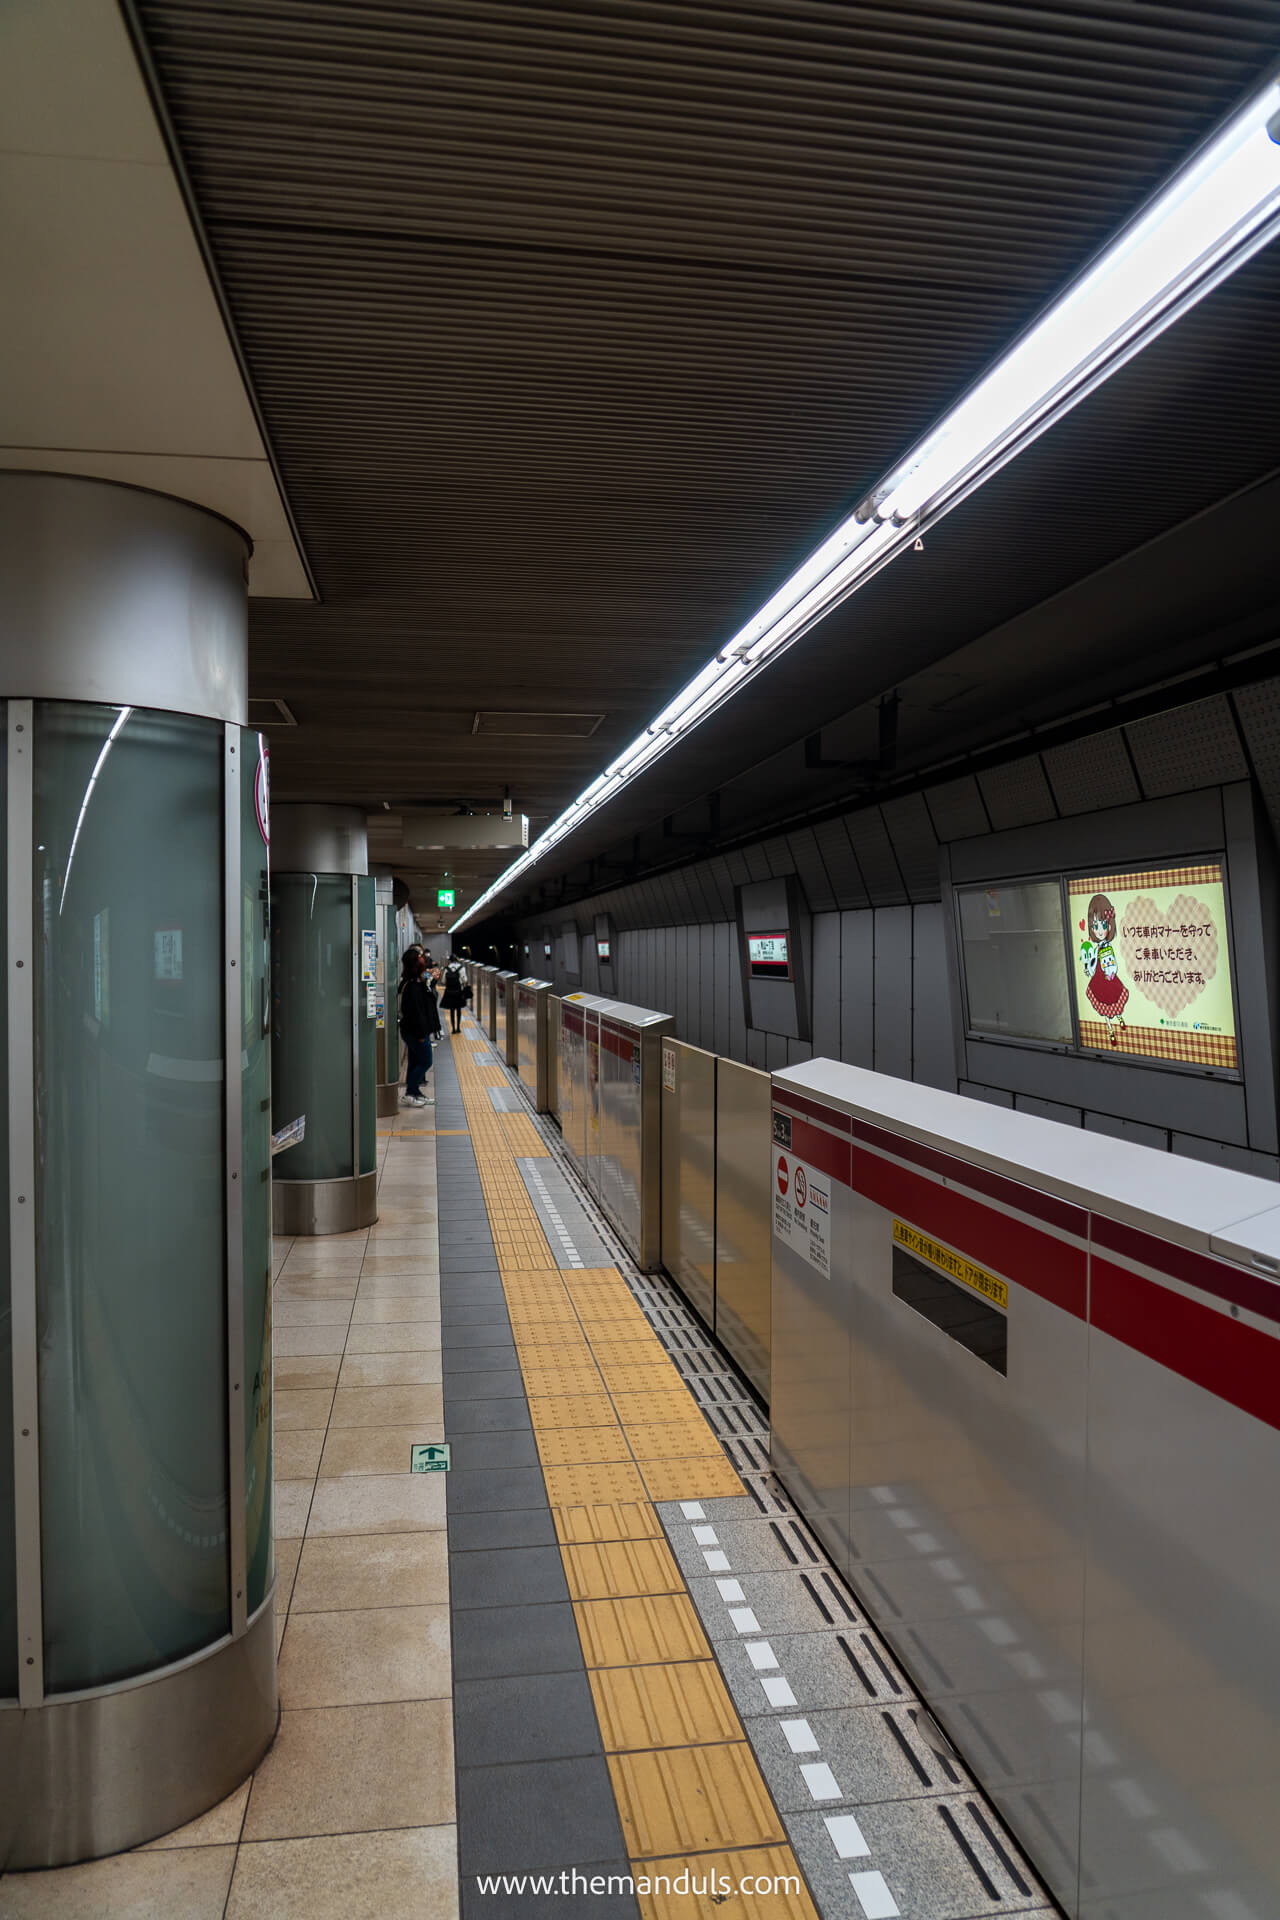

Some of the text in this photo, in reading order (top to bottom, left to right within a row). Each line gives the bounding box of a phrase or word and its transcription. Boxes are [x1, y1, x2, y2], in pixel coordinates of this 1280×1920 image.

[1123, 924, 1211, 938] いつも車内マナーを守って
[1135, 948, 1198, 960] ご乗車いただき、
[1133, 971, 1206, 985] ありがとうございます。
